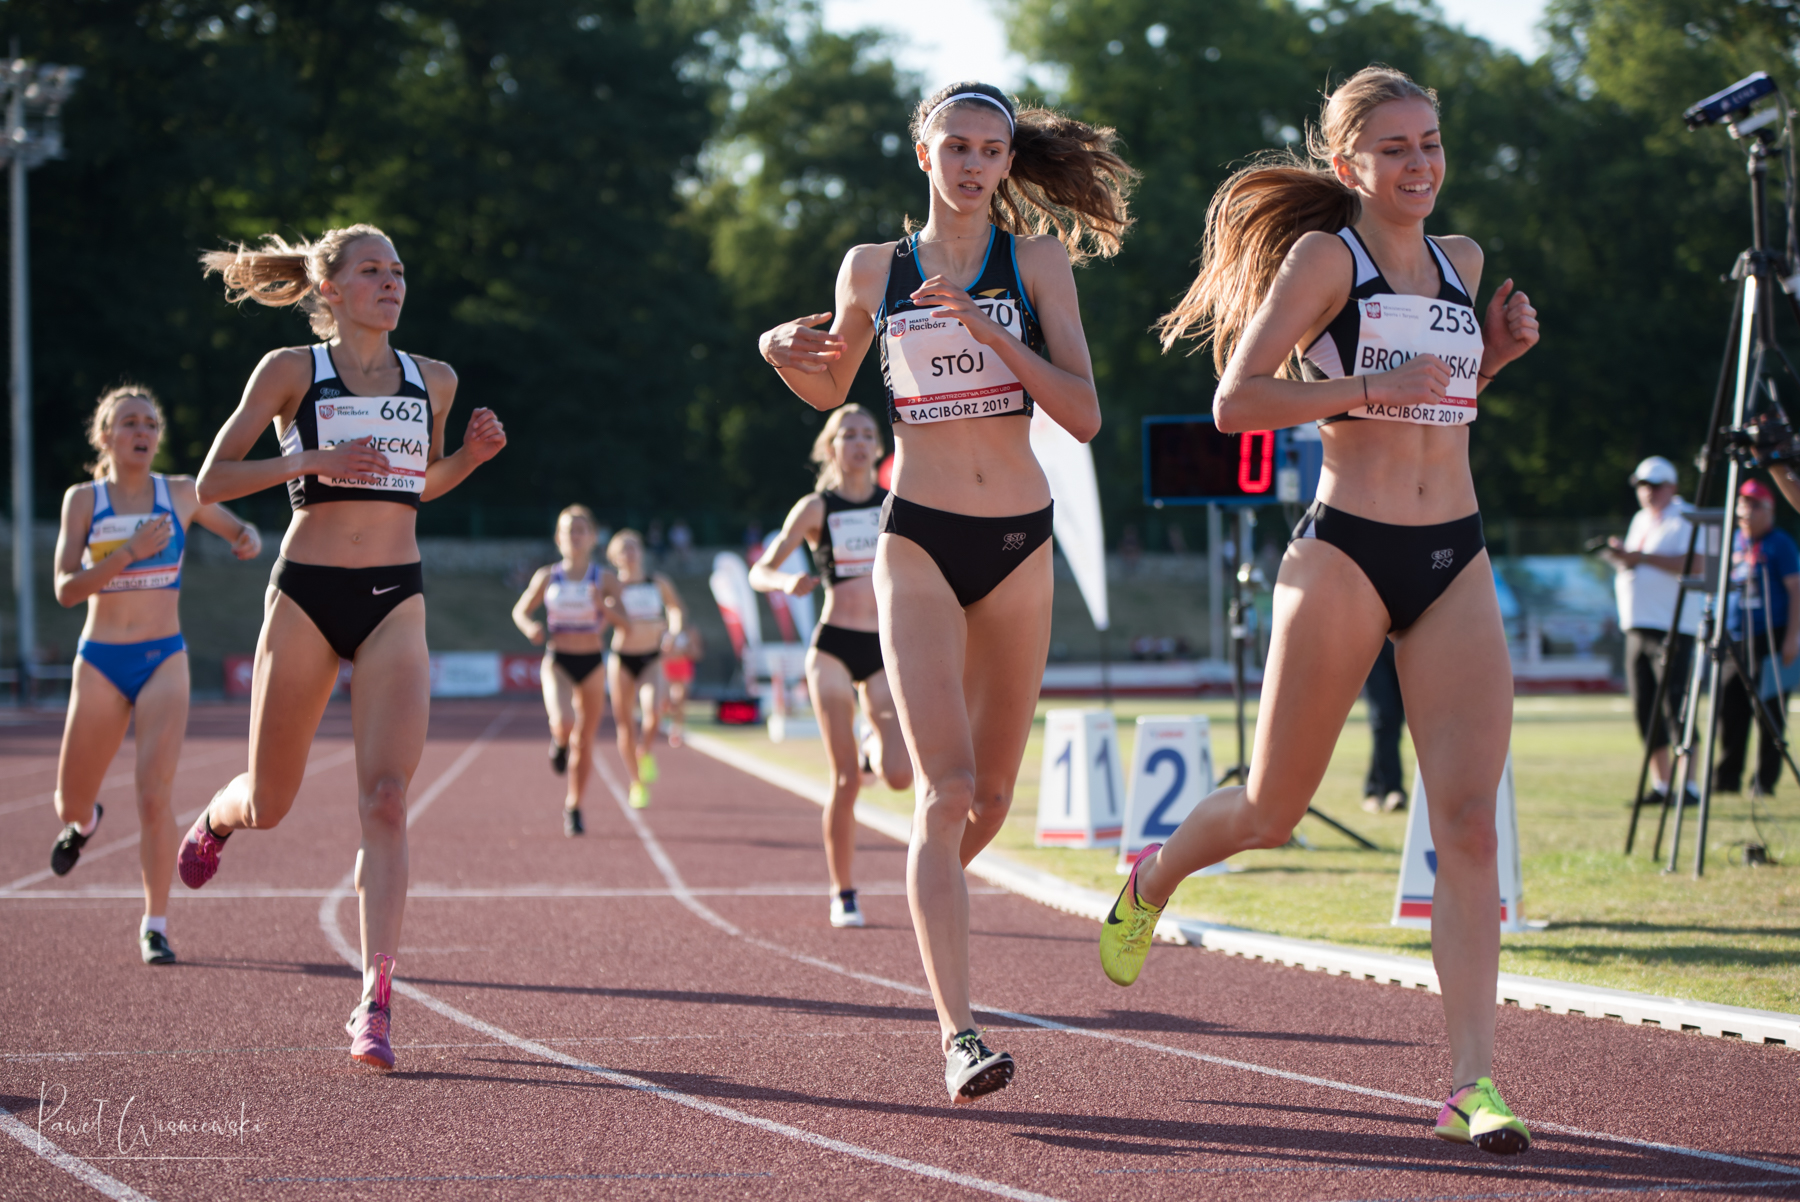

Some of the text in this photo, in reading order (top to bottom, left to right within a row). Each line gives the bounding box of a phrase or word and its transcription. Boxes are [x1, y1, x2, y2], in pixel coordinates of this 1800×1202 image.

[909, 321, 946, 331] Racibórz
[957, 303, 1013, 327] 70
[1429, 304, 1476, 335] 253
[931, 349, 984, 377] STÓJ
[918, 395, 934, 403] PZLA
[935, 391, 979, 401] MISTRZOSTWA
[980, 387, 999, 396] POLSKI
[380, 401, 423, 423] 662
[910, 397, 1010, 421] RACIBÓRZ 2019
[1366, 402, 1463, 423] RACIBÓRZ 2019
[1238, 430, 1274, 493] 0
[391, 478, 415, 489] 2019
[1055, 740, 1072, 817] 1
[1095, 737, 1116, 817] 1
[1141, 747, 1187, 838] 2
